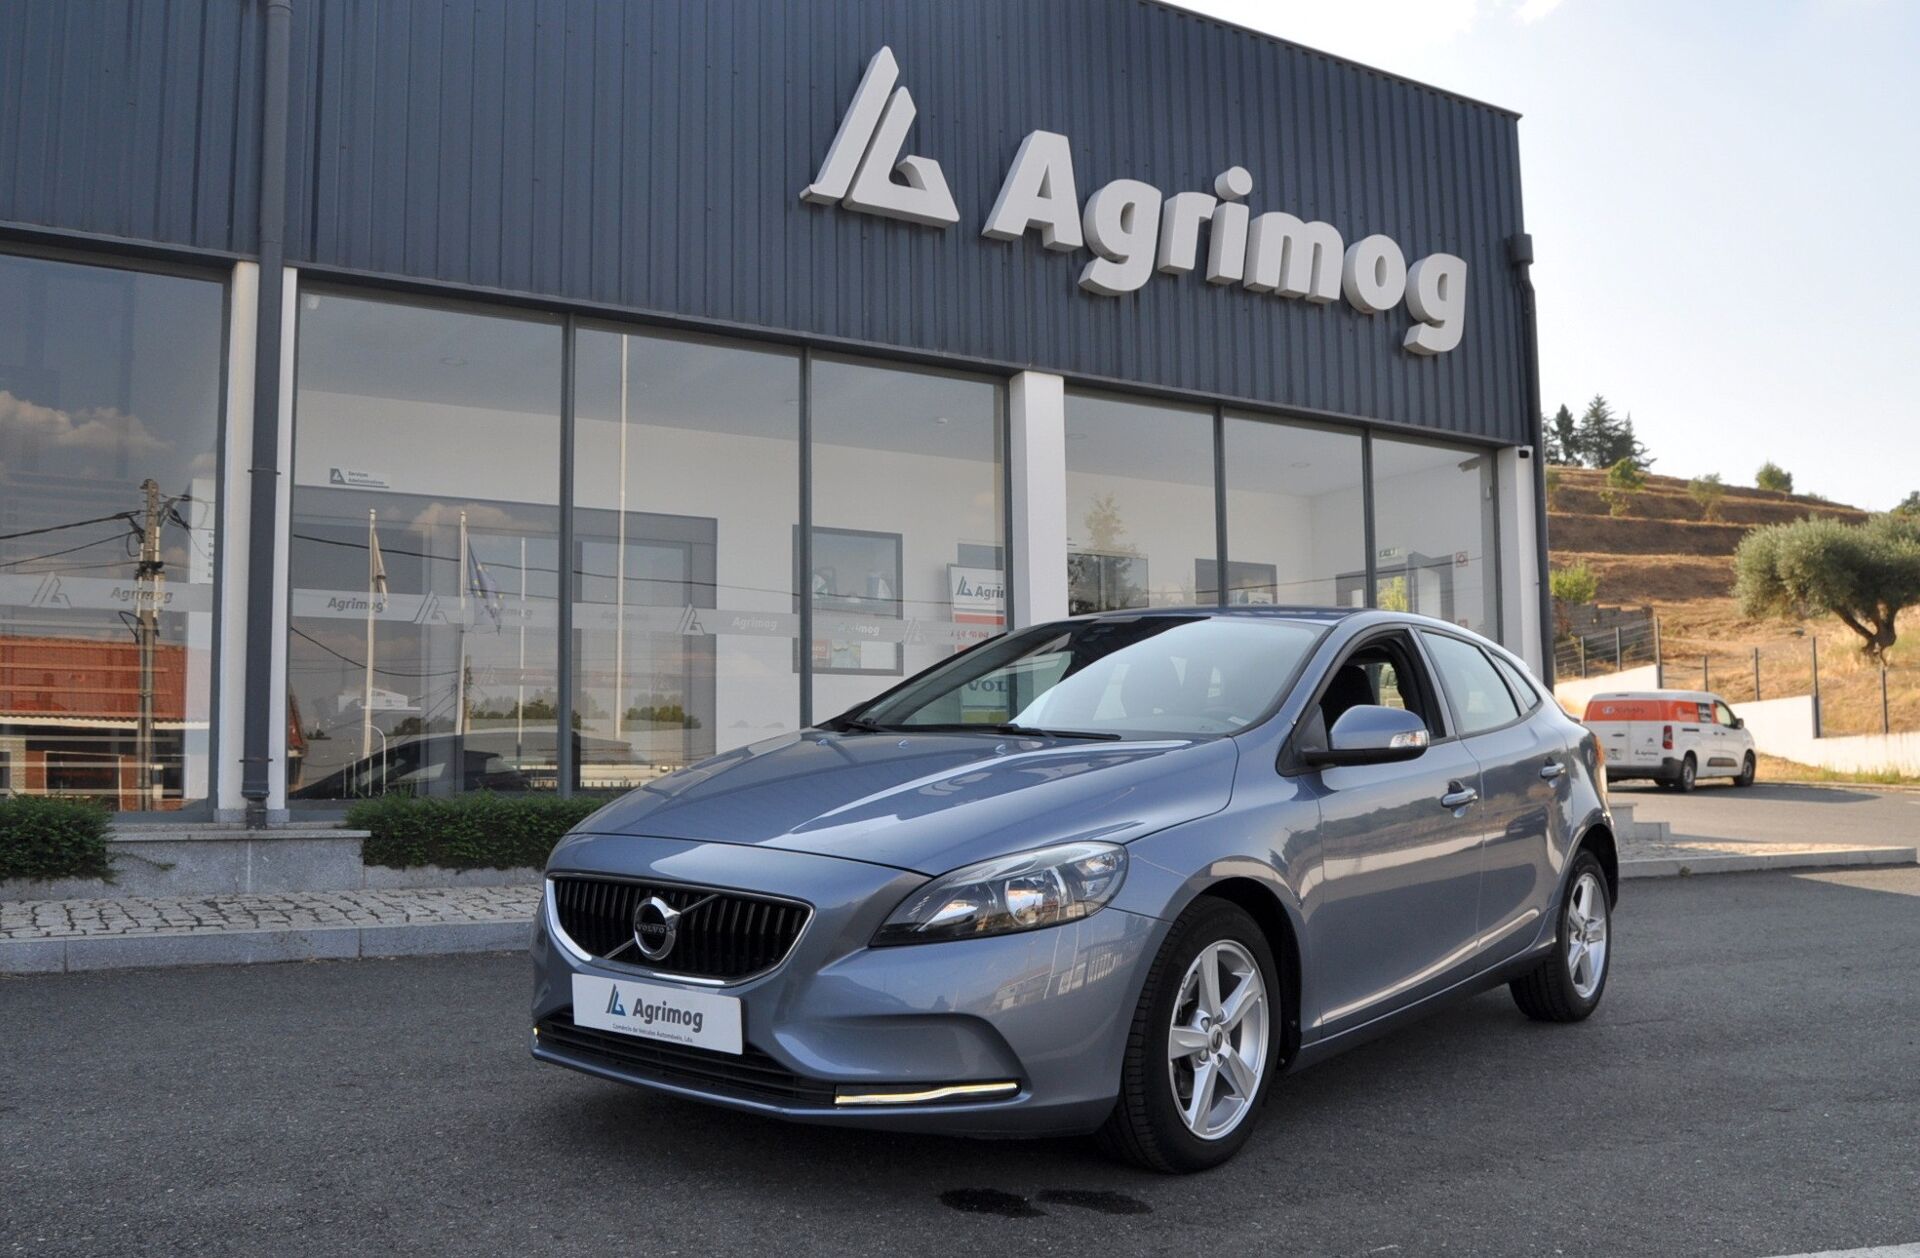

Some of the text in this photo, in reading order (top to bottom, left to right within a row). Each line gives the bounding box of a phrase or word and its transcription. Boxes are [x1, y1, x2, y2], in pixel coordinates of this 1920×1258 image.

[981, 129, 1467, 355] Agrimog
[327, 597, 384, 613] Agrimog
[636, 923, 665, 934] VOLVO
[632, 998, 703, 1033] Agrimog
